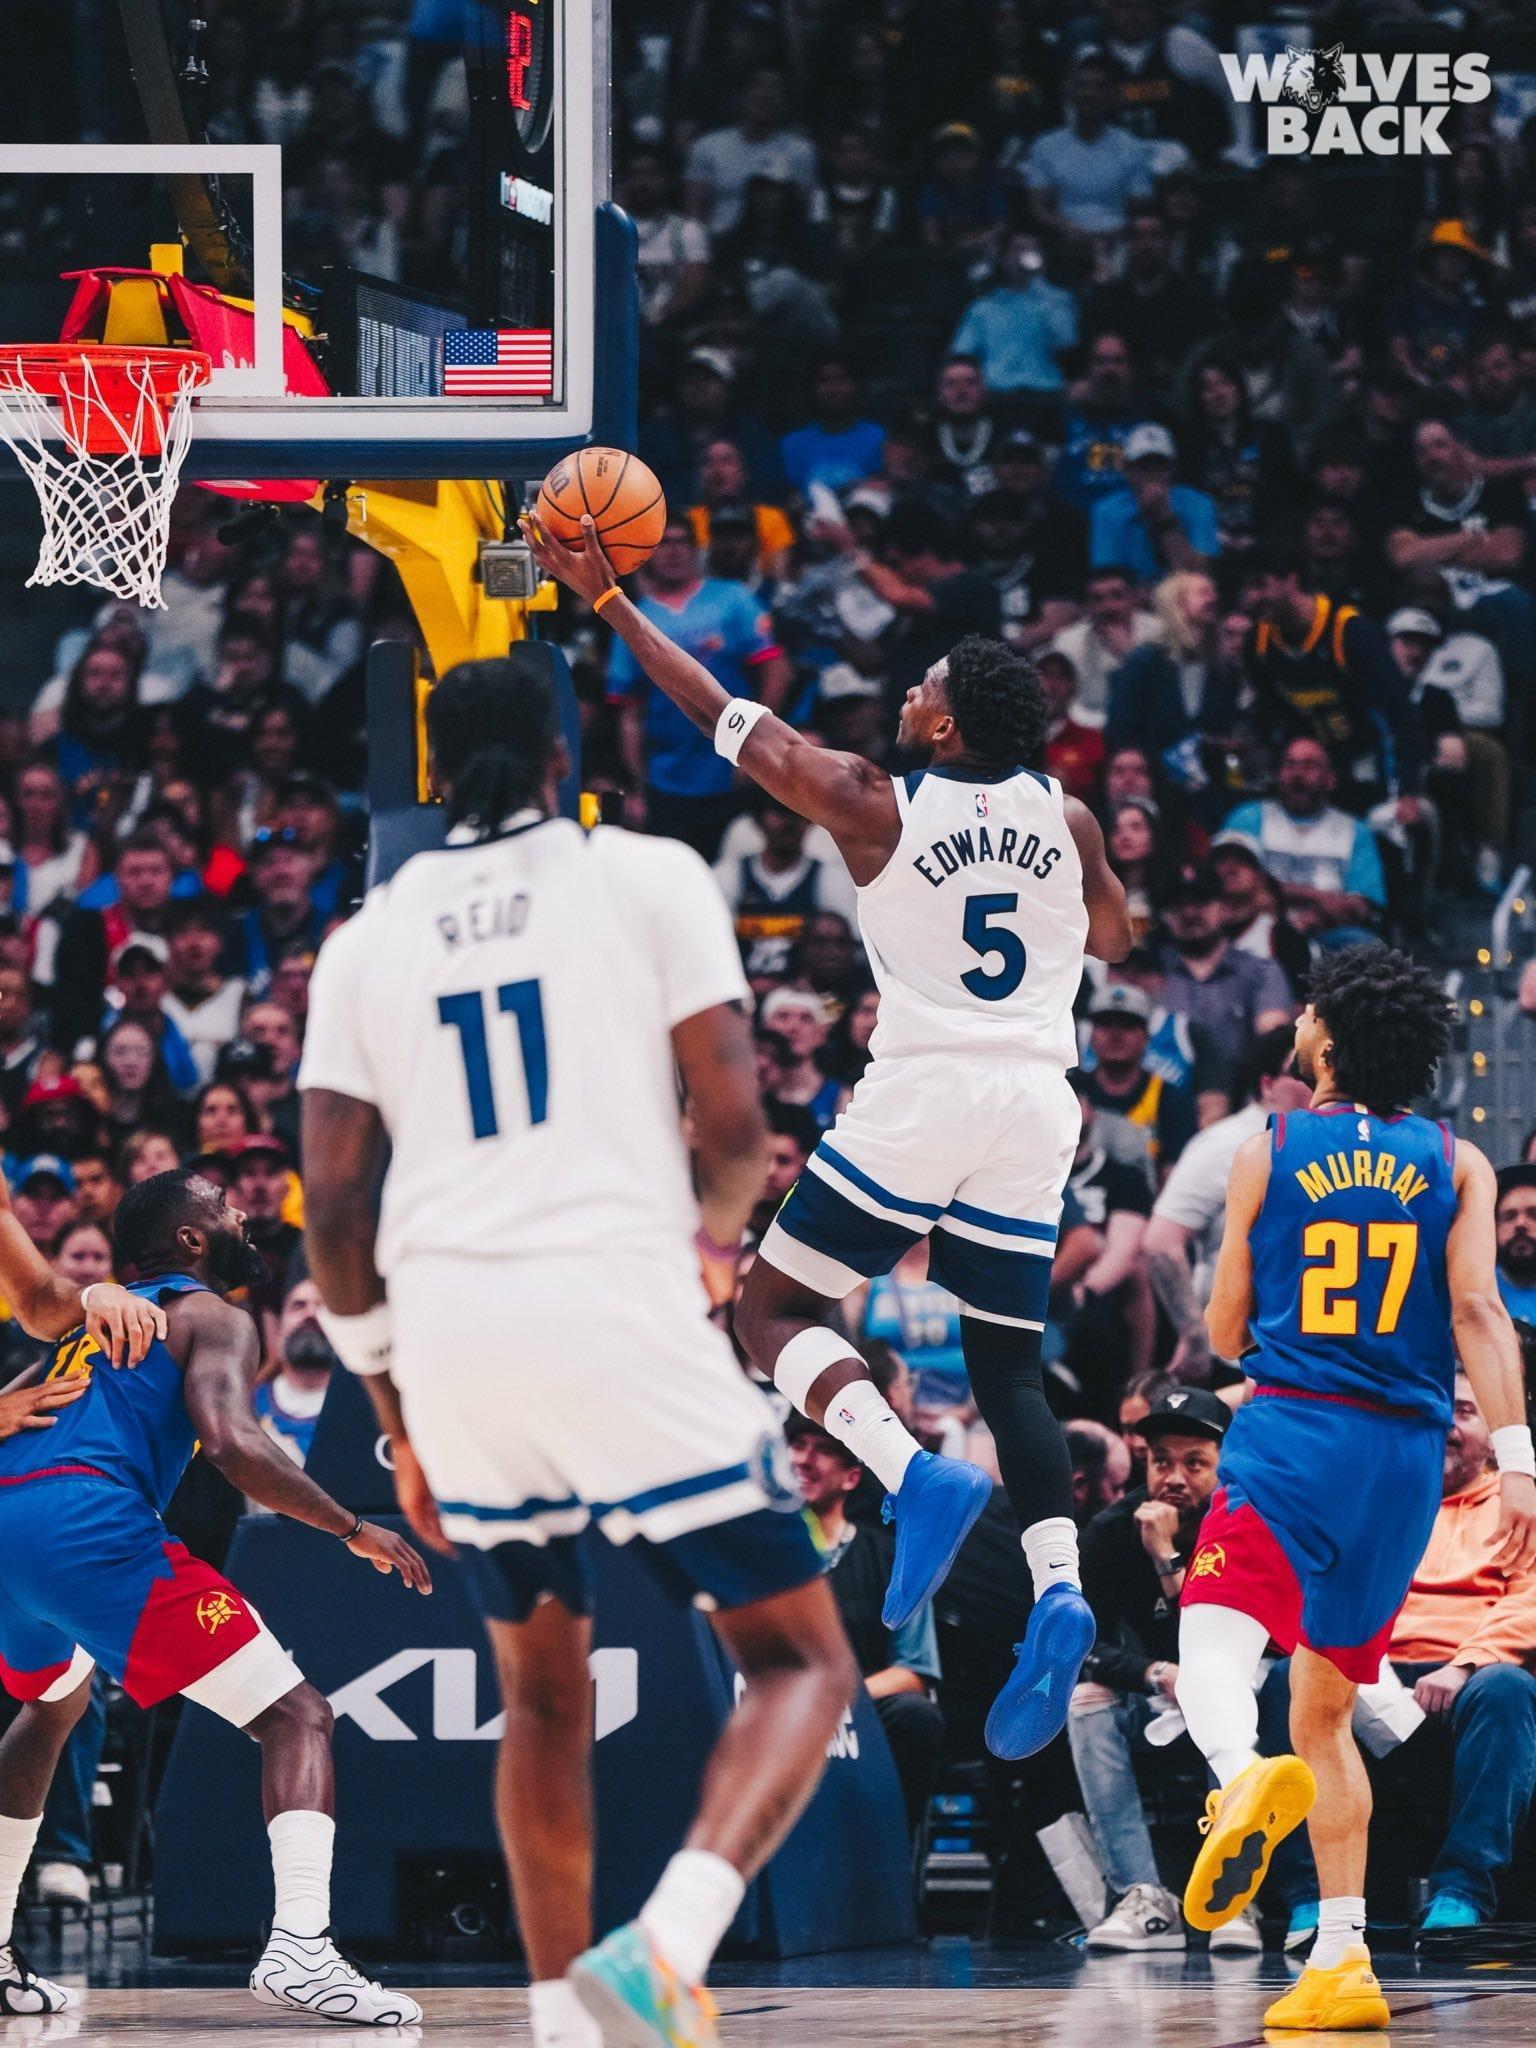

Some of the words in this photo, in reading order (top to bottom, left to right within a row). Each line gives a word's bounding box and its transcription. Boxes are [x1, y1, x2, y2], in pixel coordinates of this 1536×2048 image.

[912, 826, 1062, 888] EDWARDS
[960, 892, 1027, 1002] 5
[437, 978, 549, 1139] 11
[1295, 1149, 1429, 1207] MURRAY
[1300, 1220, 1419, 1336] 27
